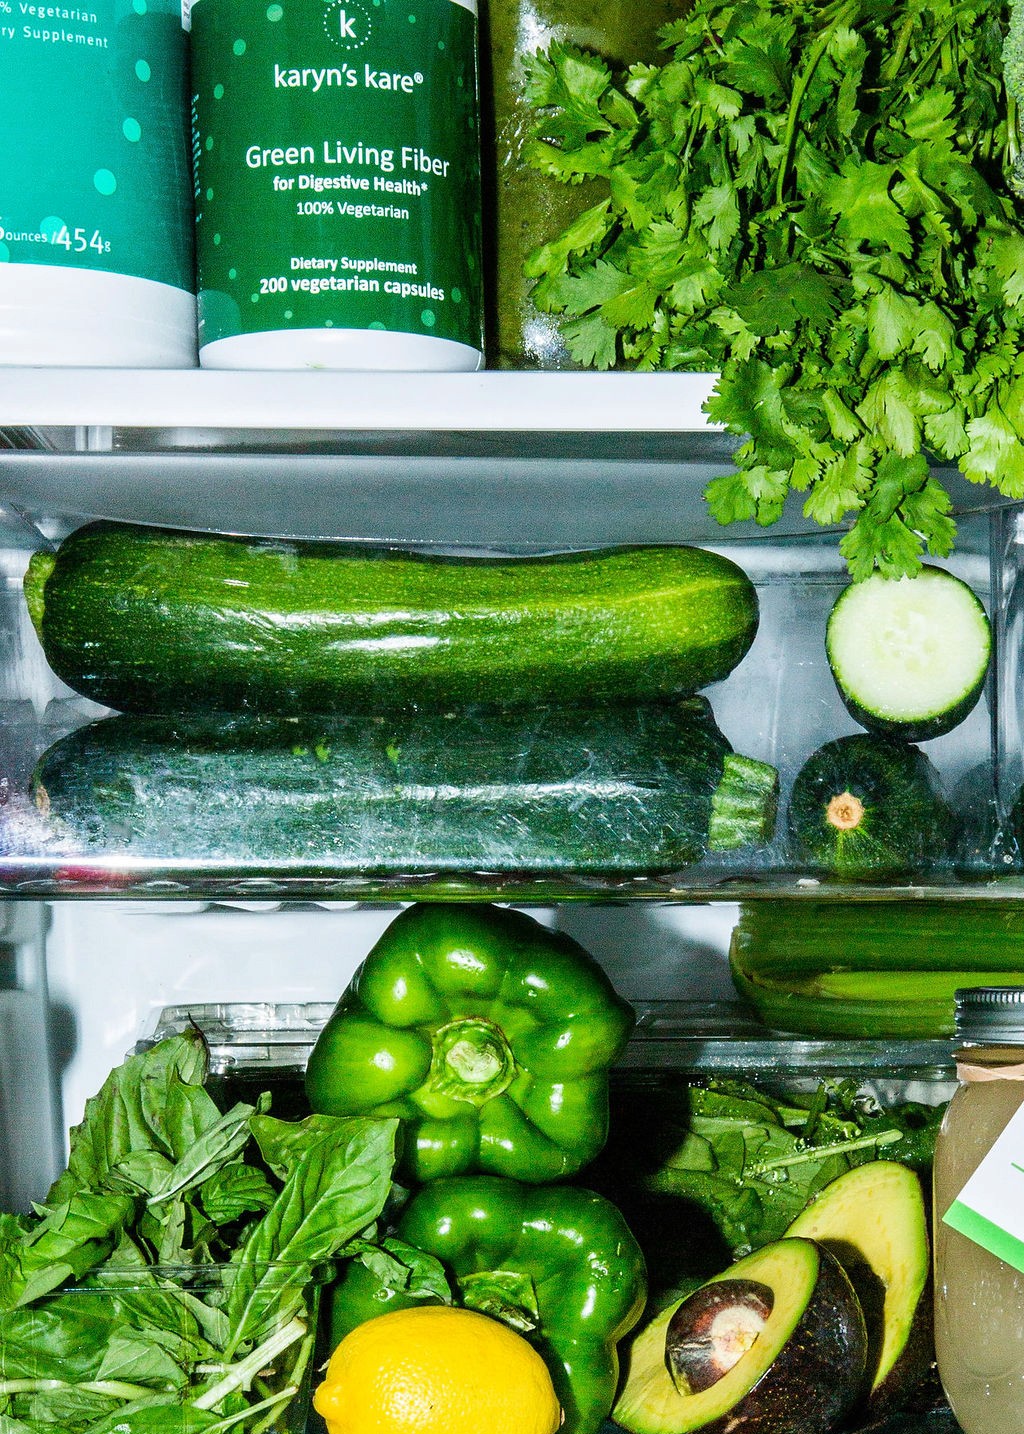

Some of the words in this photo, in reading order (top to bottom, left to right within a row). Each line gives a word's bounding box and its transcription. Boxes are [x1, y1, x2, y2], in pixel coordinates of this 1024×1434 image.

[19, 3, 97, 23] Vegetarian
[23, 26, 108, 48] Supplement
[246, 141, 314, 169] Green
[323, 141, 394, 172] Living
[402, 147, 450, 178] Fiber
[273, 176, 295, 191] for
[299, 175, 369, 193] Digestive
[297, 201, 334, 216] 100%
[337, 201, 409, 220] Vegetarian
[290, 257, 338, 273] Dietary
[341, 256, 417, 275] Supplement
[260, 278, 287, 294] 200
[291, 276, 379, 297] vegetarian
[384, 280, 445, 300] capsules
